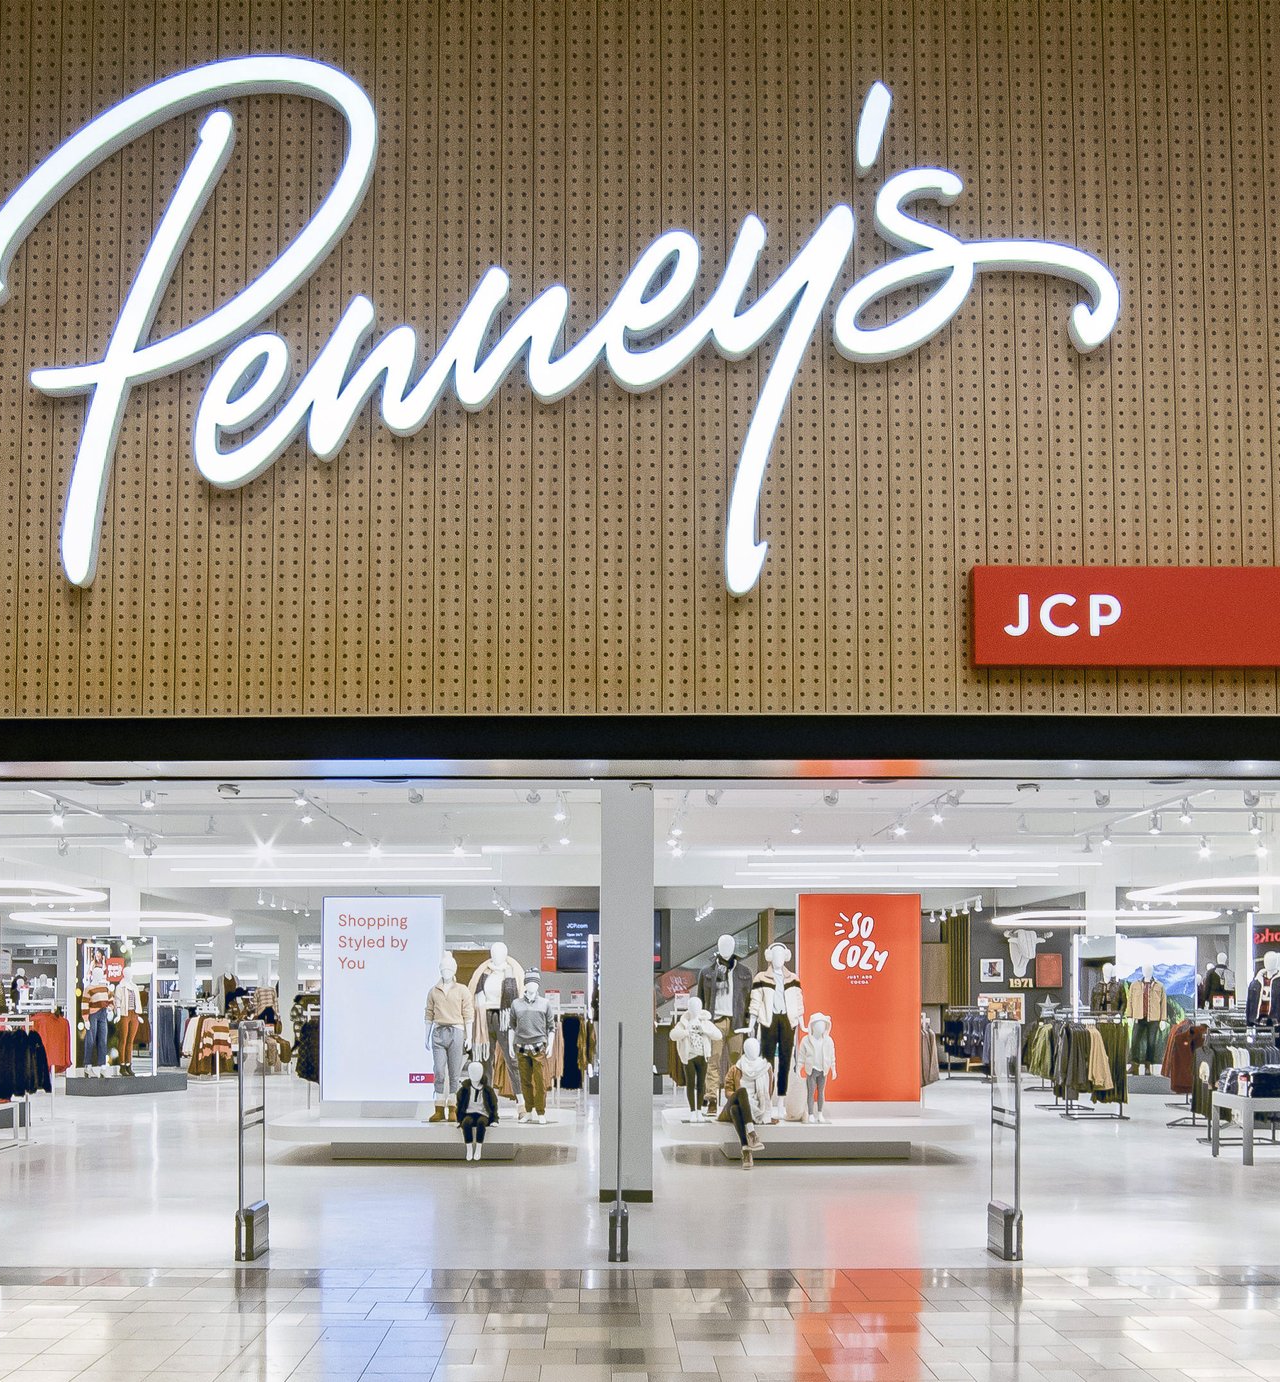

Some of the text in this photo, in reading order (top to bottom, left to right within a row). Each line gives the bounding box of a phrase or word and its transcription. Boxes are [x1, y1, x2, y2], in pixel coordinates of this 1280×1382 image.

[1003, 593, 1122, 637] JCP
[338, 914, 408, 930] Shopping
[848, 912, 874, 939] SO
[338, 935, 408, 952] Styled by
[544, 919, 555, 960] just ask
[338, 956, 365, 970] You
[830, 939, 889, 972] COZY
[1009, 978, 1034, 988] 1971
